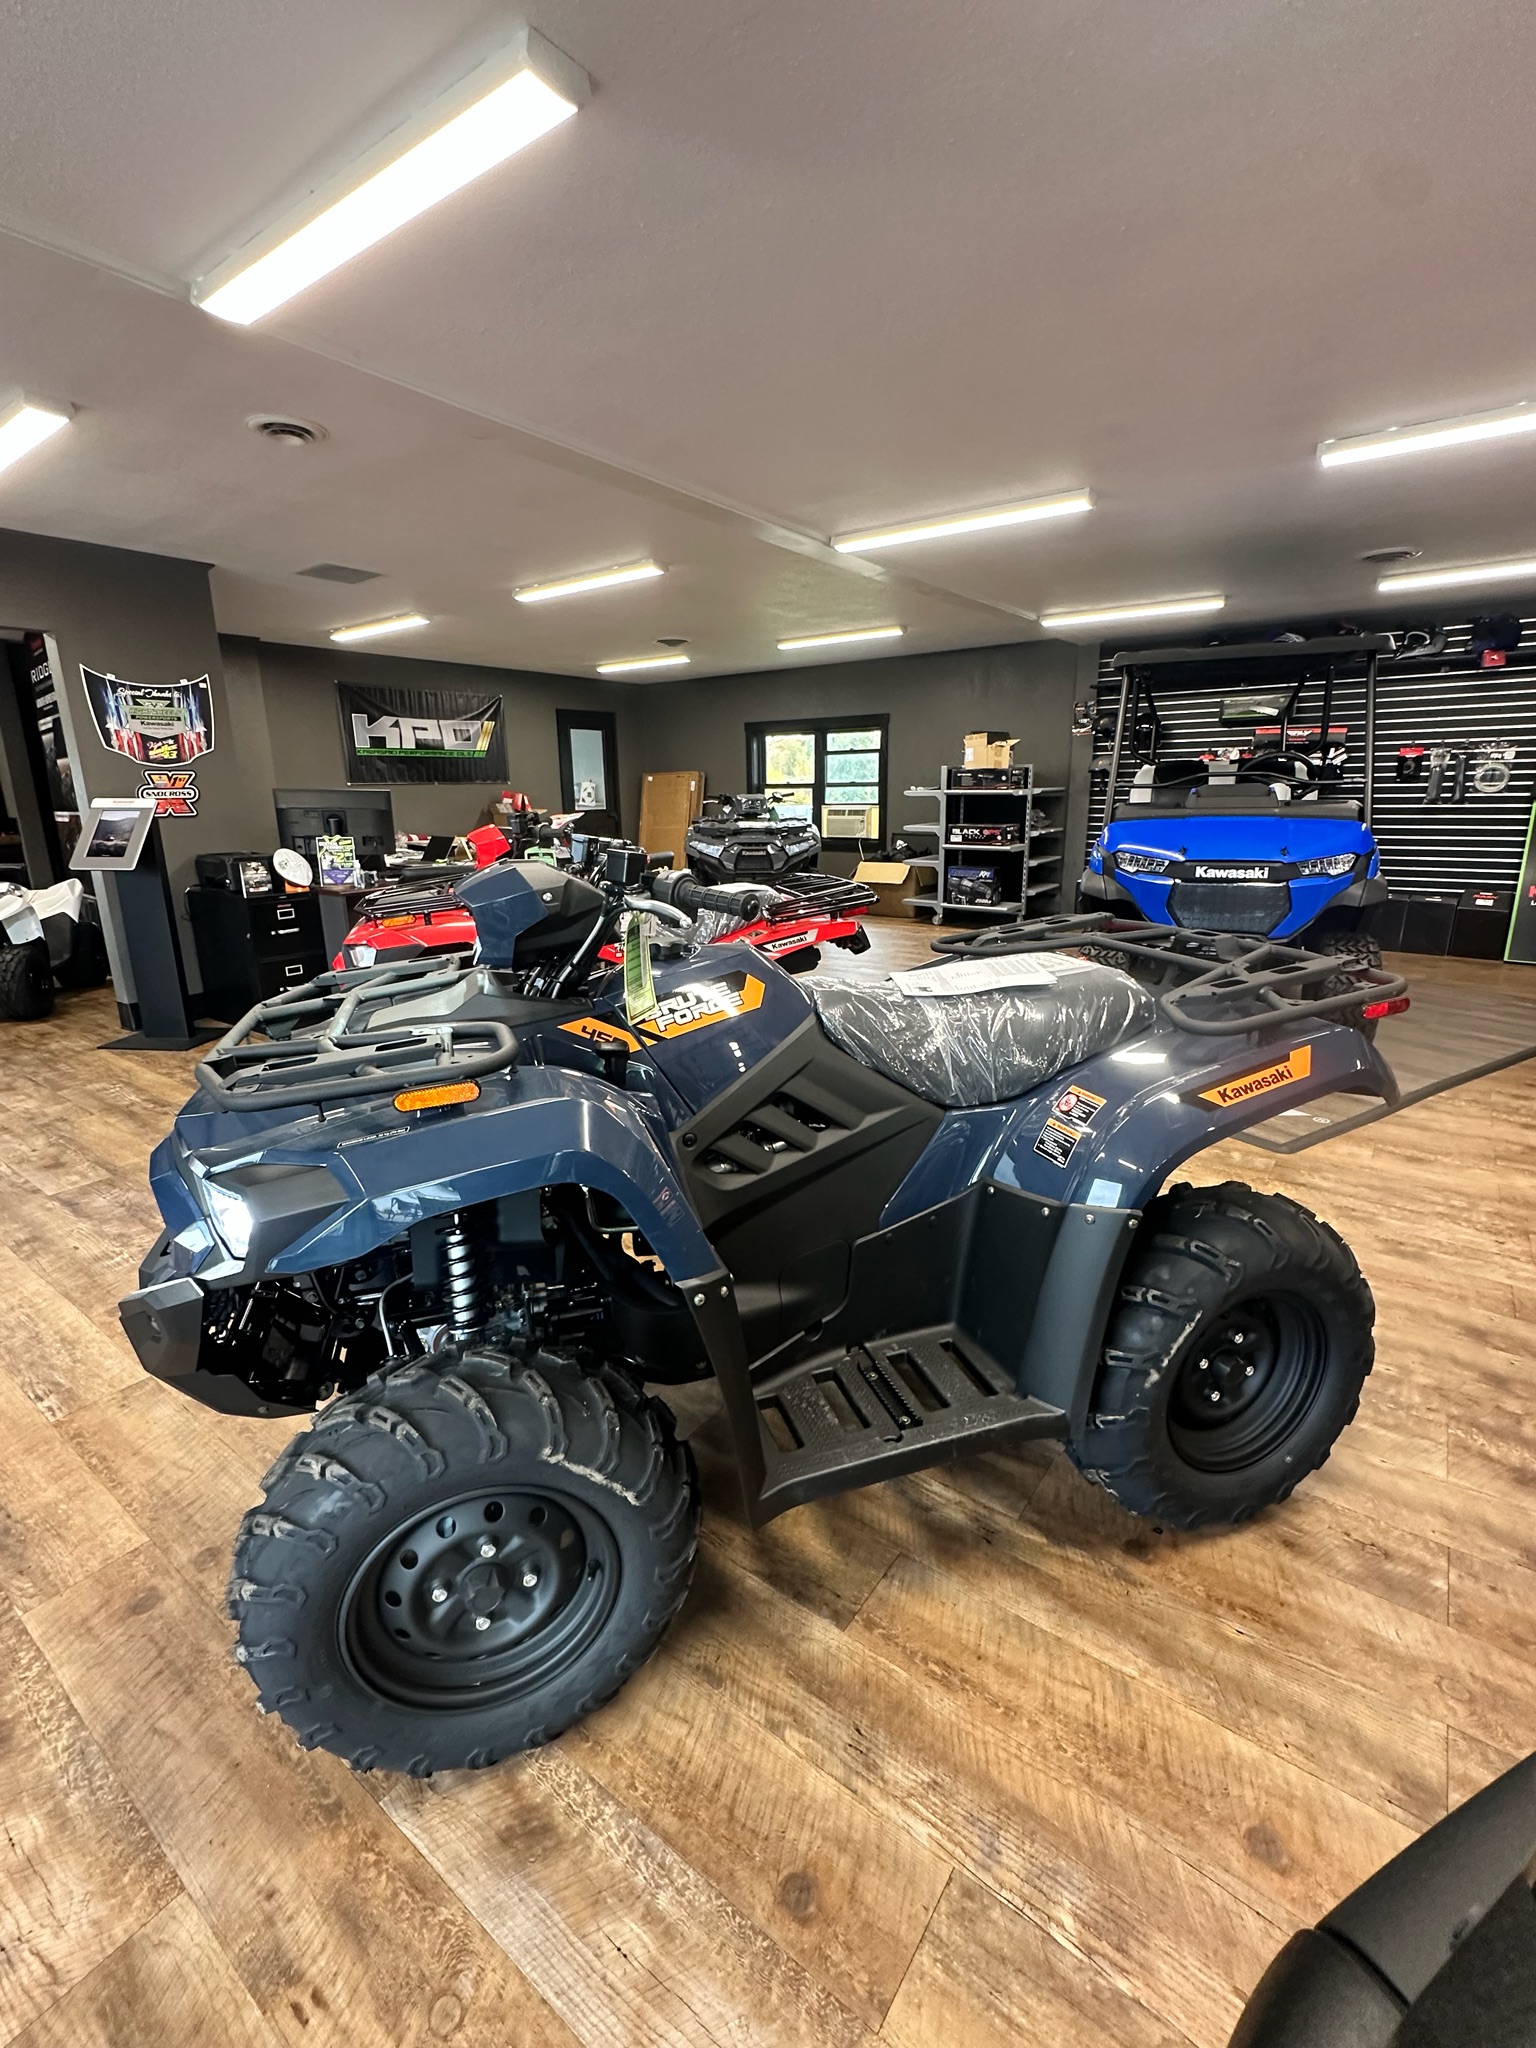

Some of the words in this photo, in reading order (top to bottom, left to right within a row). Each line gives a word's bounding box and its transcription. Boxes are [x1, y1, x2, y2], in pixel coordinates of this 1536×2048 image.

[31, 662, 52, 683] RIDG
[1195, 866, 1269, 879] Kawasaki
[771, 936, 807, 949] Kawasaki
[655, 991, 744, 1033] FORCE
[581, 1025, 625, 1042] 45
[1217, 1065, 1294, 1103] Kawasaki
